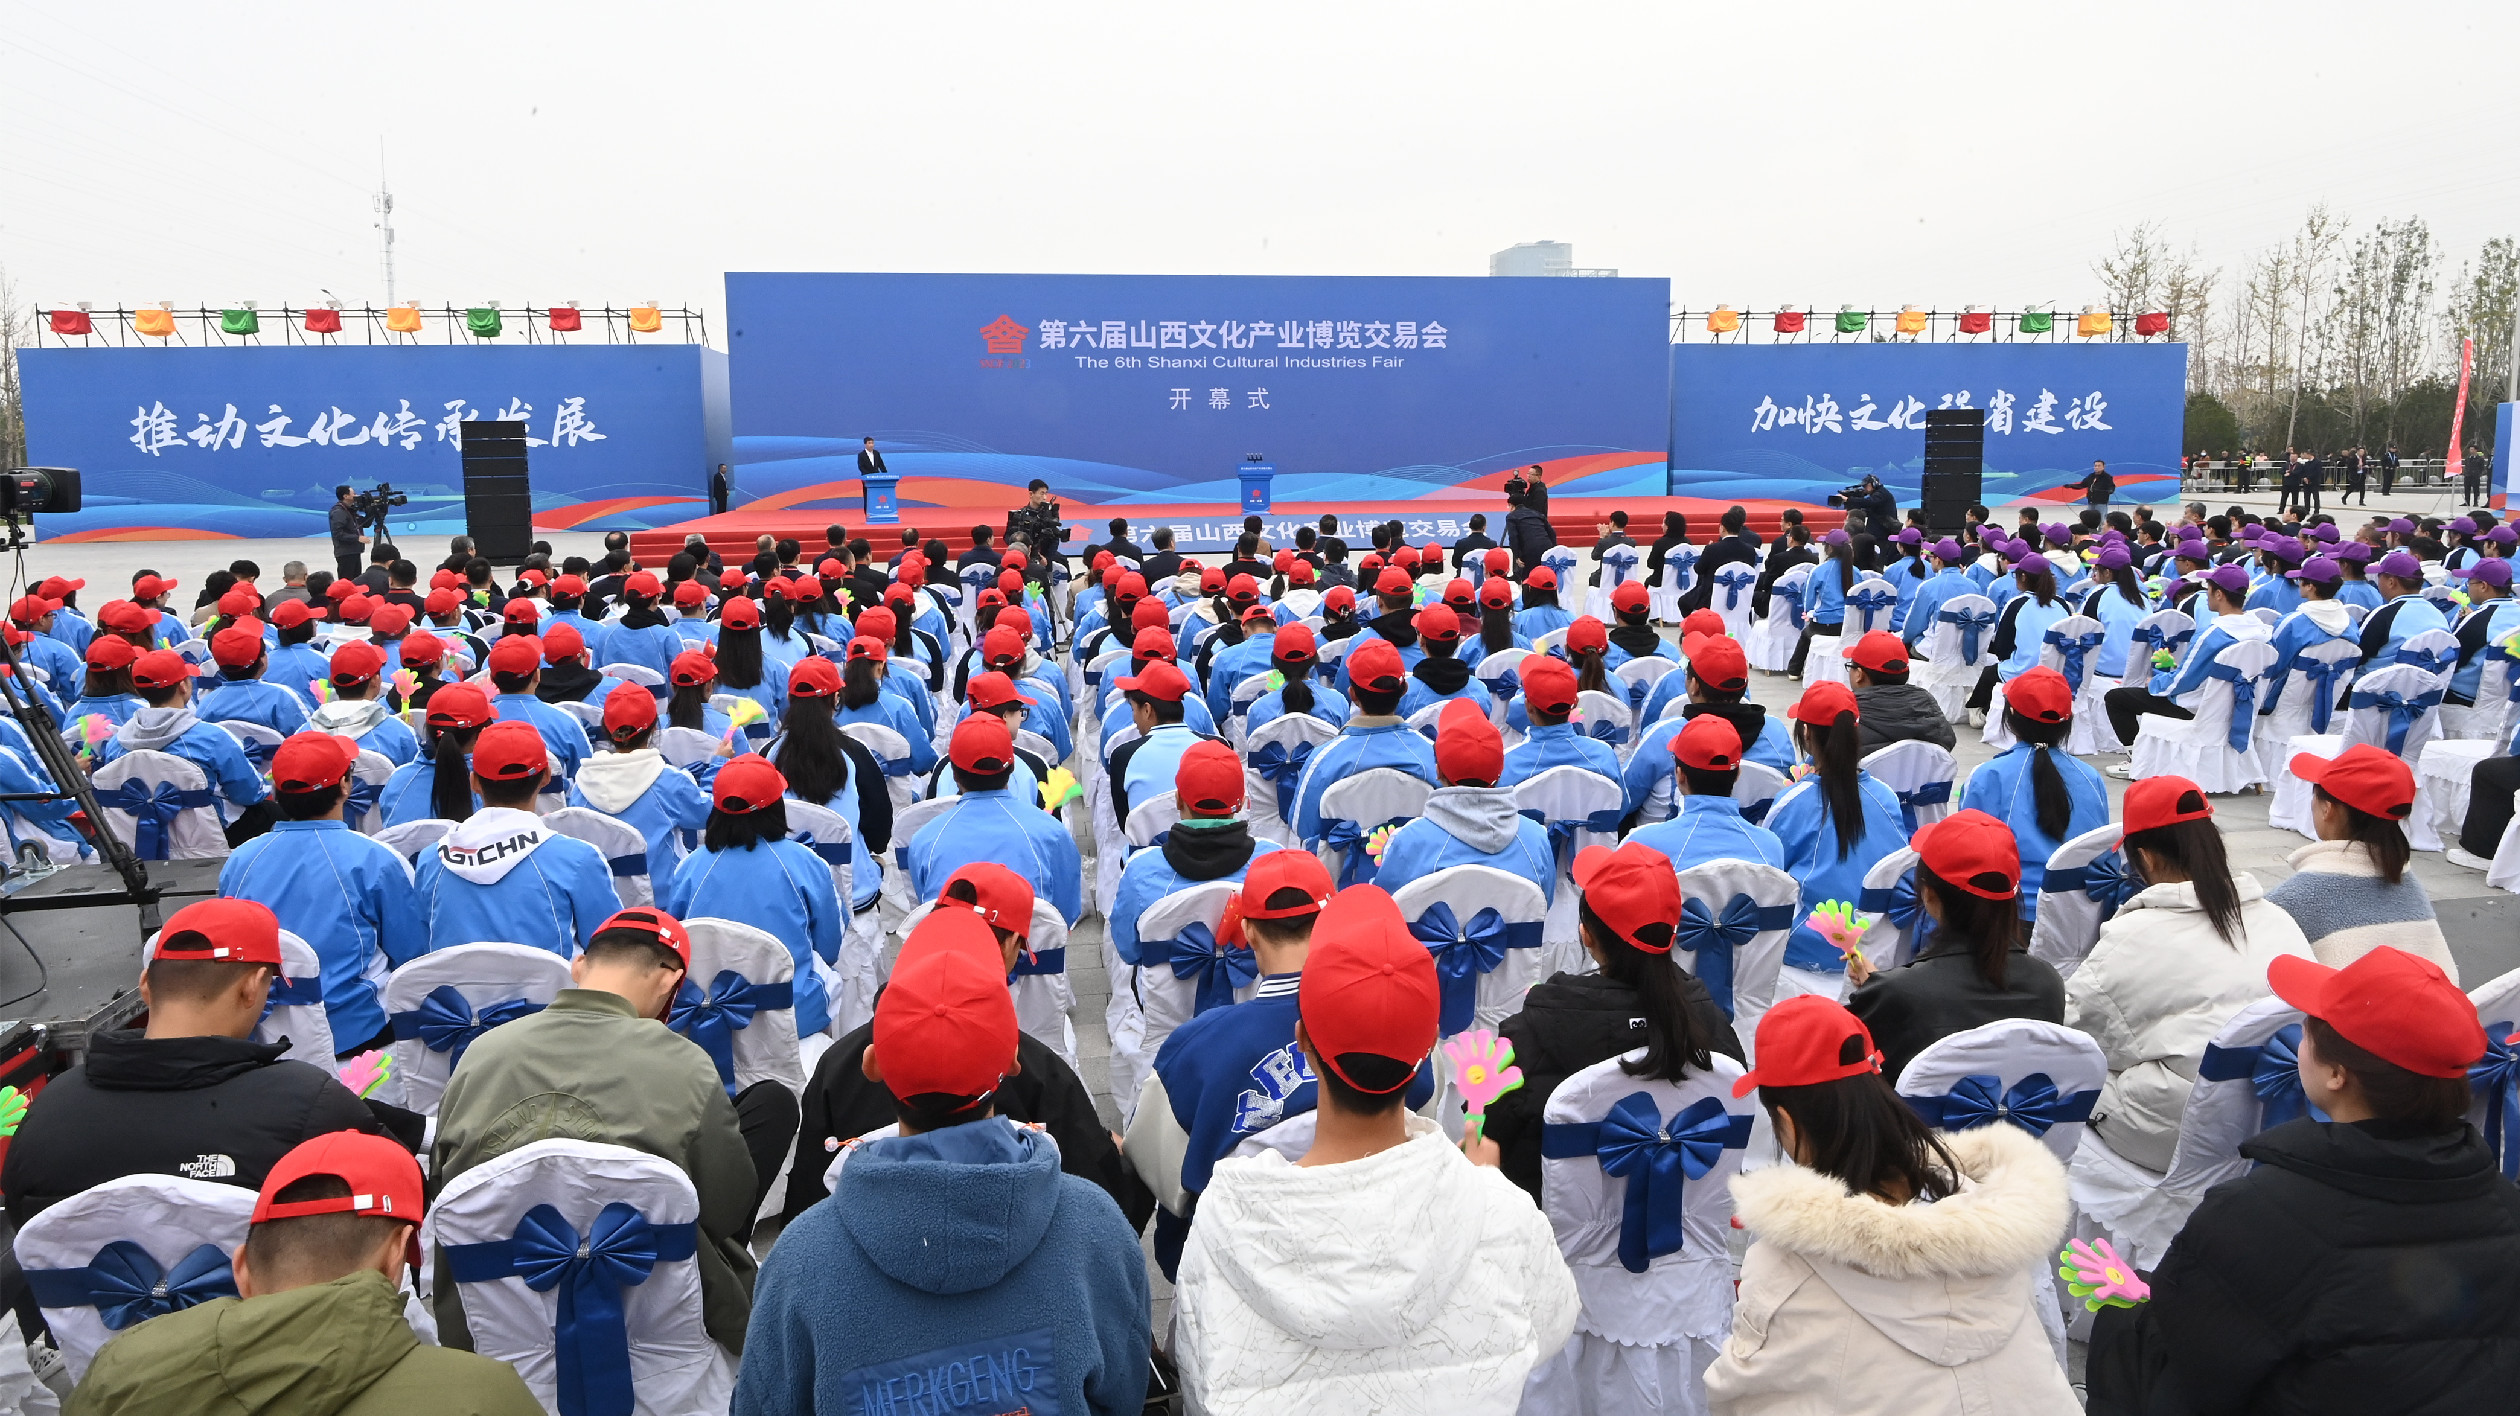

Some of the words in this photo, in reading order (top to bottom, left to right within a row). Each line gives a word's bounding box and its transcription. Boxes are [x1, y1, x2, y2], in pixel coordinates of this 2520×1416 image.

[1038, 319, 1448, 349] 第六届山西文化产业博览交易会
[1075, 356, 1109, 368] The
[1114, 356, 1141, 368] 6th
[1147, 356, 1207, 368] Shanxi
[1212, 356, 1279, 368] Cultural
[1285, 356, 1367, 368] Industries
[1372, 356, 1405, 368] Fair
[1169, 387, 1270, 410] 开幕式
[197, 1154, 218, 1163] THE
[180, 1162, 217, 1171] NORTH
[190, 1170, 217, 1178] FACE
